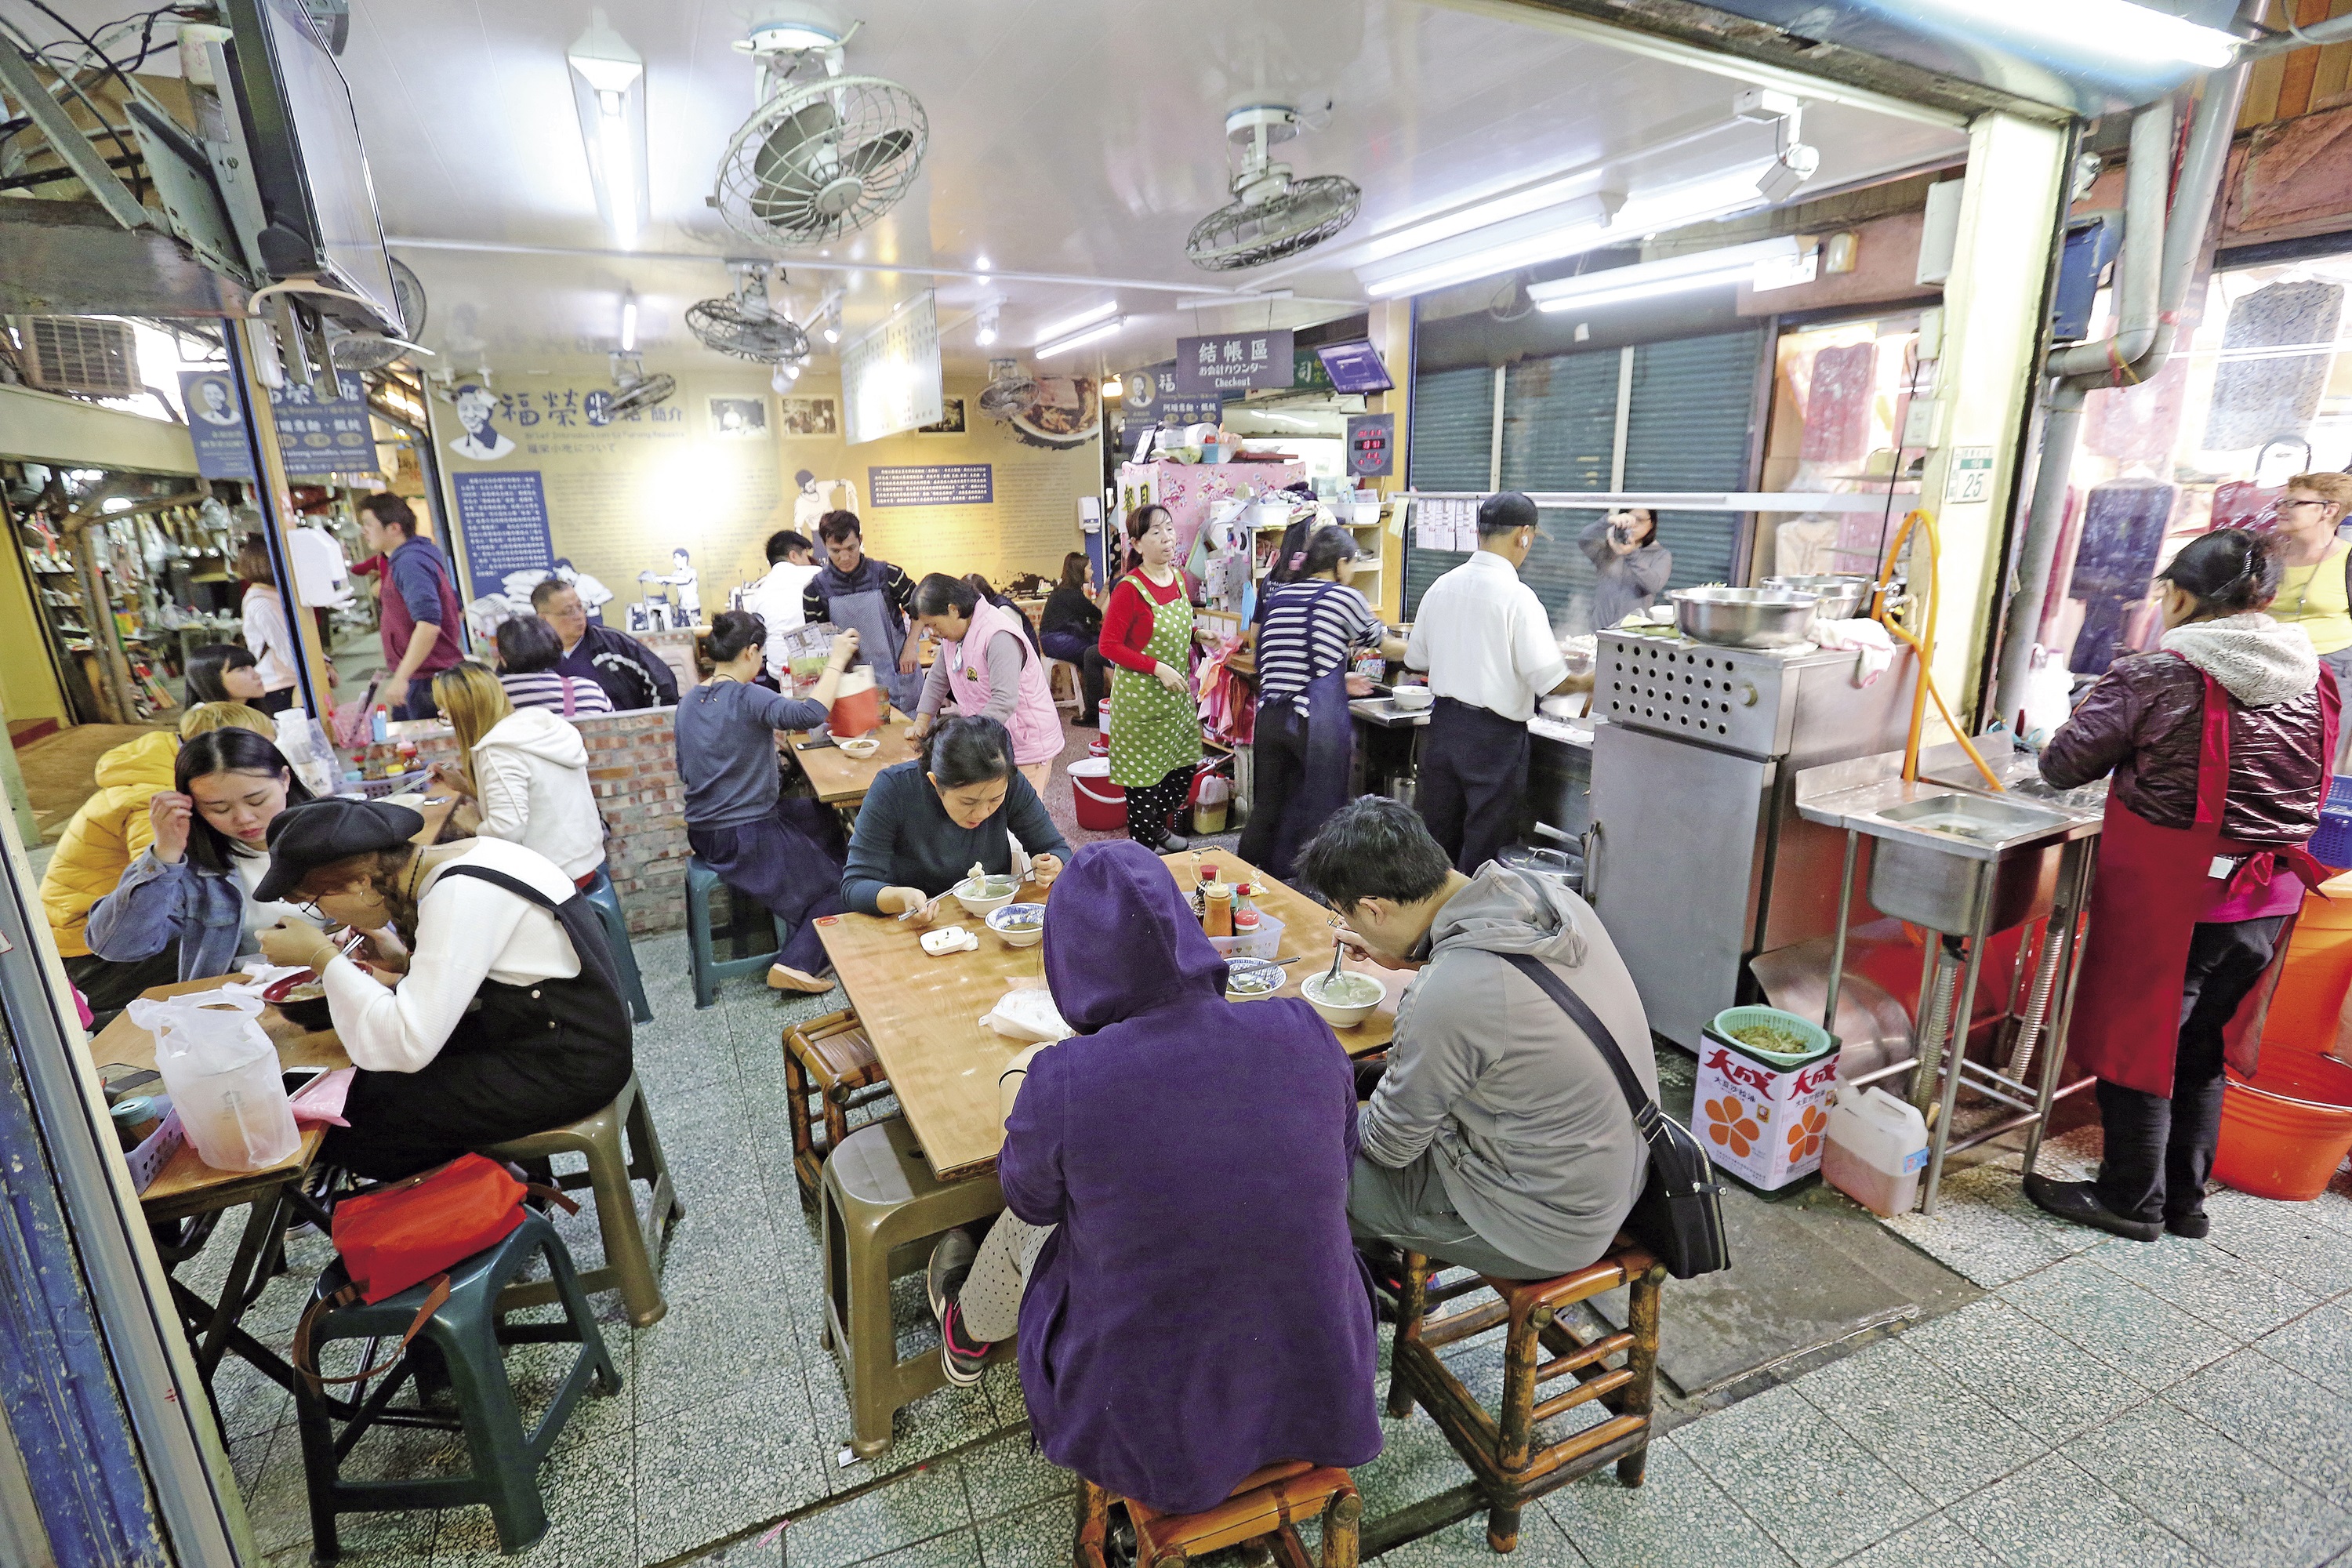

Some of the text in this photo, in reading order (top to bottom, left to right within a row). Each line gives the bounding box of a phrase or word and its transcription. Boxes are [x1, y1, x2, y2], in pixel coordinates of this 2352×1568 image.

[1198, 338, 1268, 363] 結帳區
[1215, 376, 1250, 389] Checkout
[1962, 473, 1984, 498] 25
[1704, 1049, 1779, 1102] 大成
[1788, 1054, 1840, 1101] 大成
